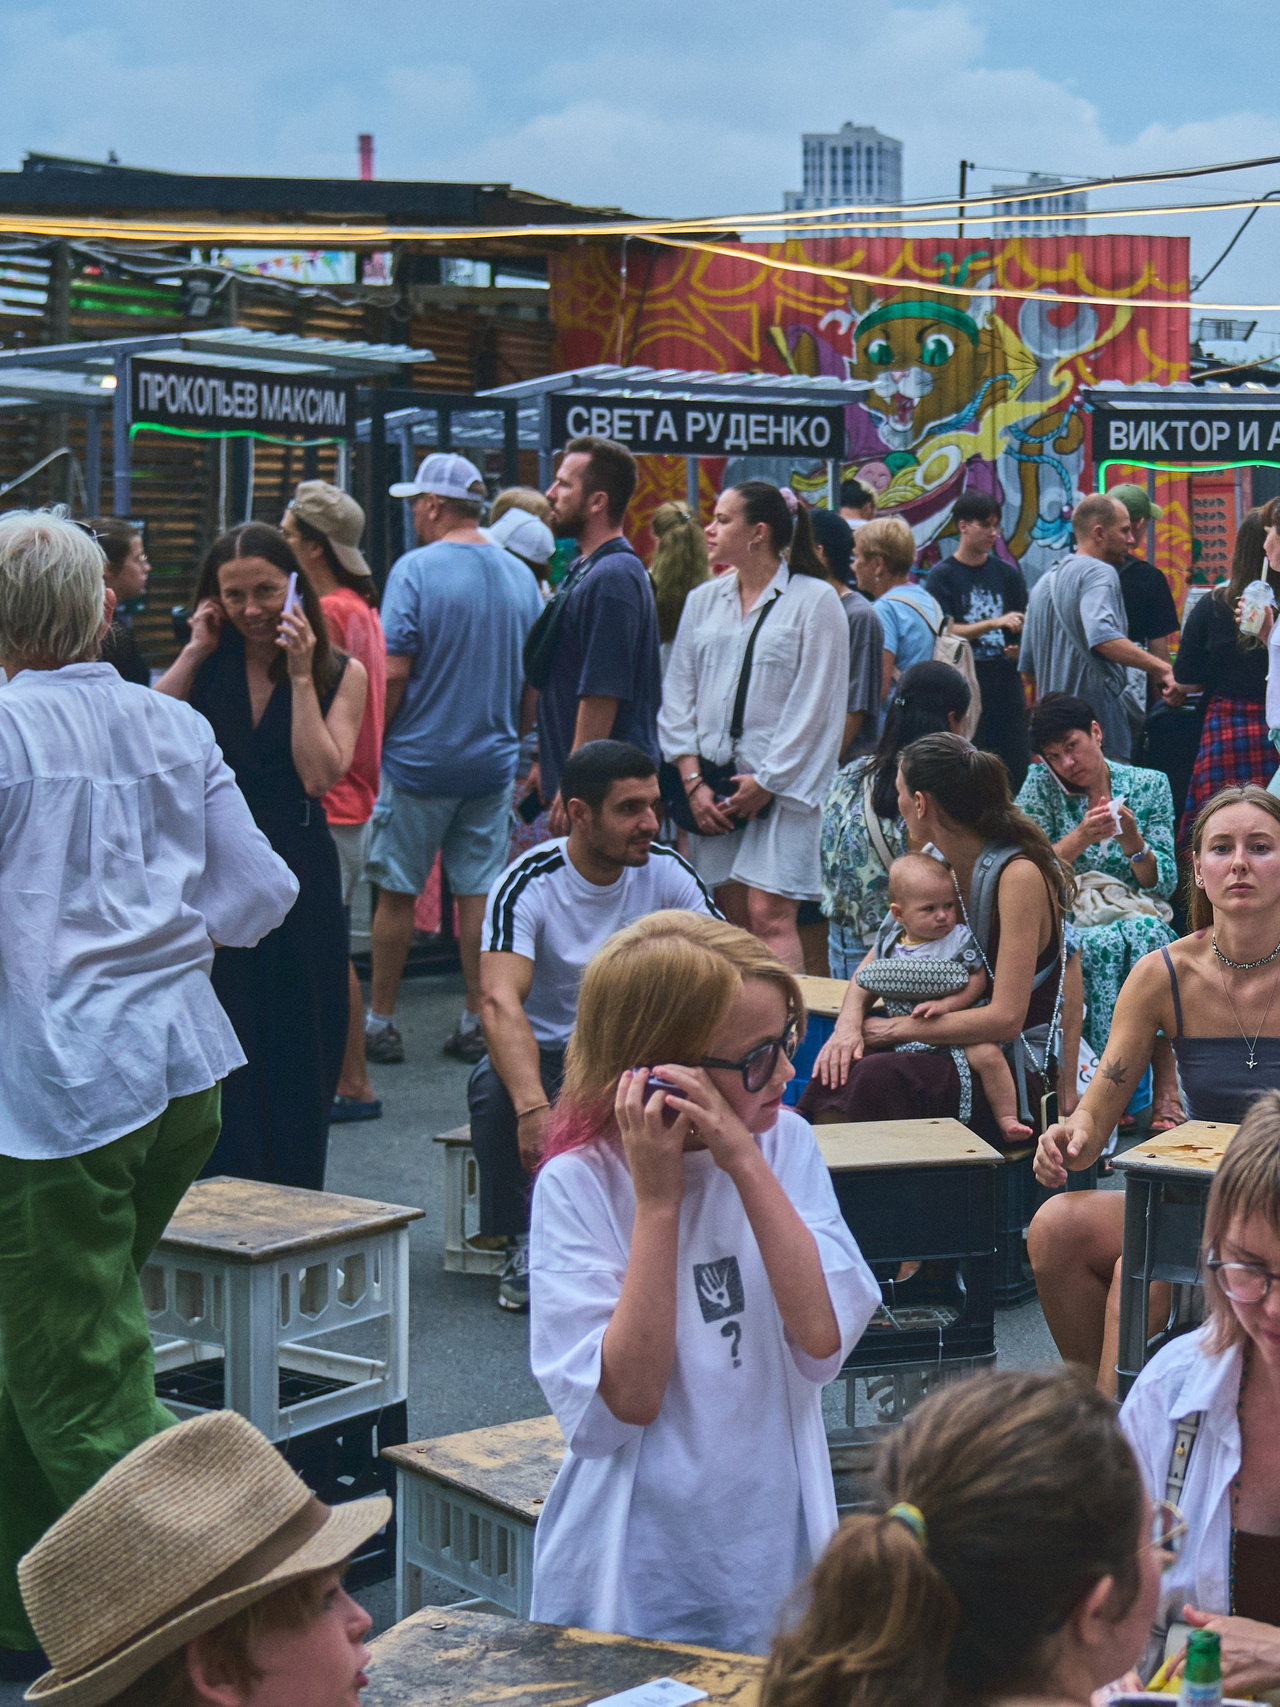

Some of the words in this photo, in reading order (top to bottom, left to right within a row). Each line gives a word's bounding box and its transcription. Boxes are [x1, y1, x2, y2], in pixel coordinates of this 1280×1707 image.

[138, 371, 259, 420] ПРОКОПЬЕВ
[260, 383, 347, 427] МАКСИМ
[566, 405, 679, 442] СВЕТА
[685, 411, 832, 451] РУДЕНКО
[1108, 420, 1231, 451] ВИКТОР
[1238, 421, 1260, 451] И
